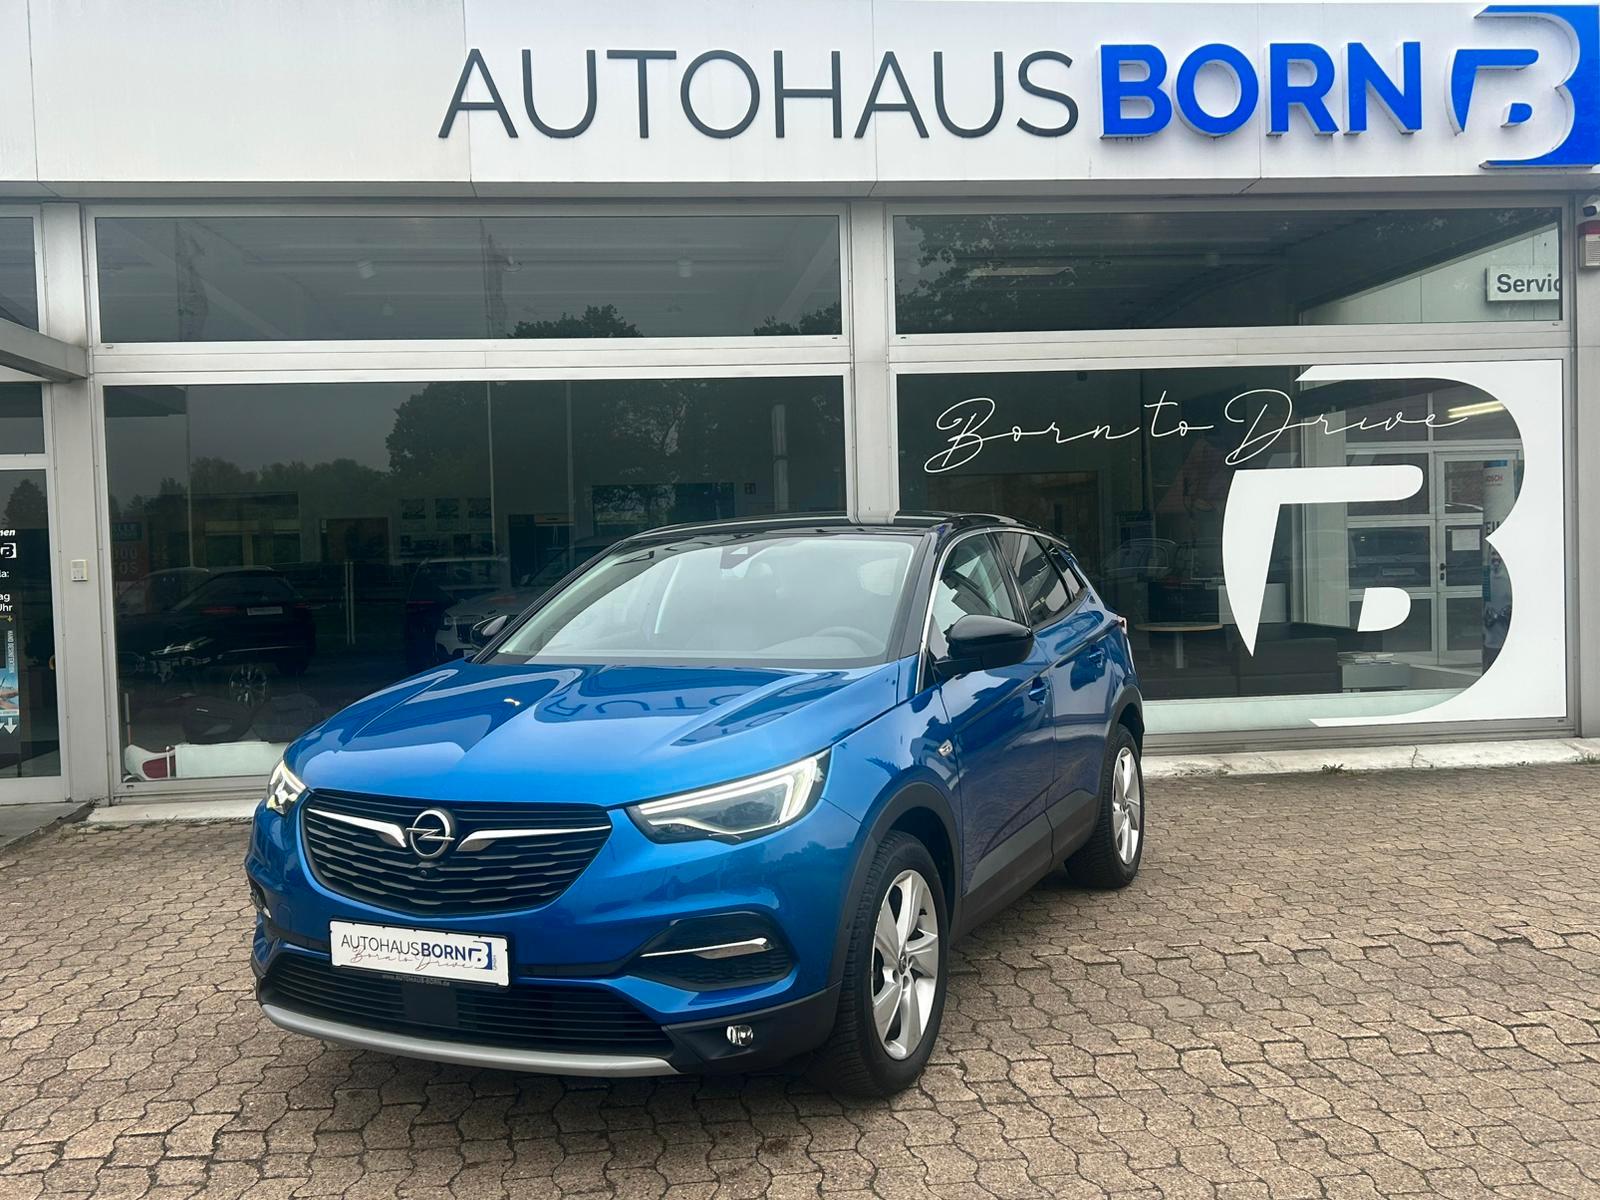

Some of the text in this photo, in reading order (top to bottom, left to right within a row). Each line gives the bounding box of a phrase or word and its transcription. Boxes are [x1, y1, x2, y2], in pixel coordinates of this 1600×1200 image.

[924, 388, 1468, 473] Born to Drive
